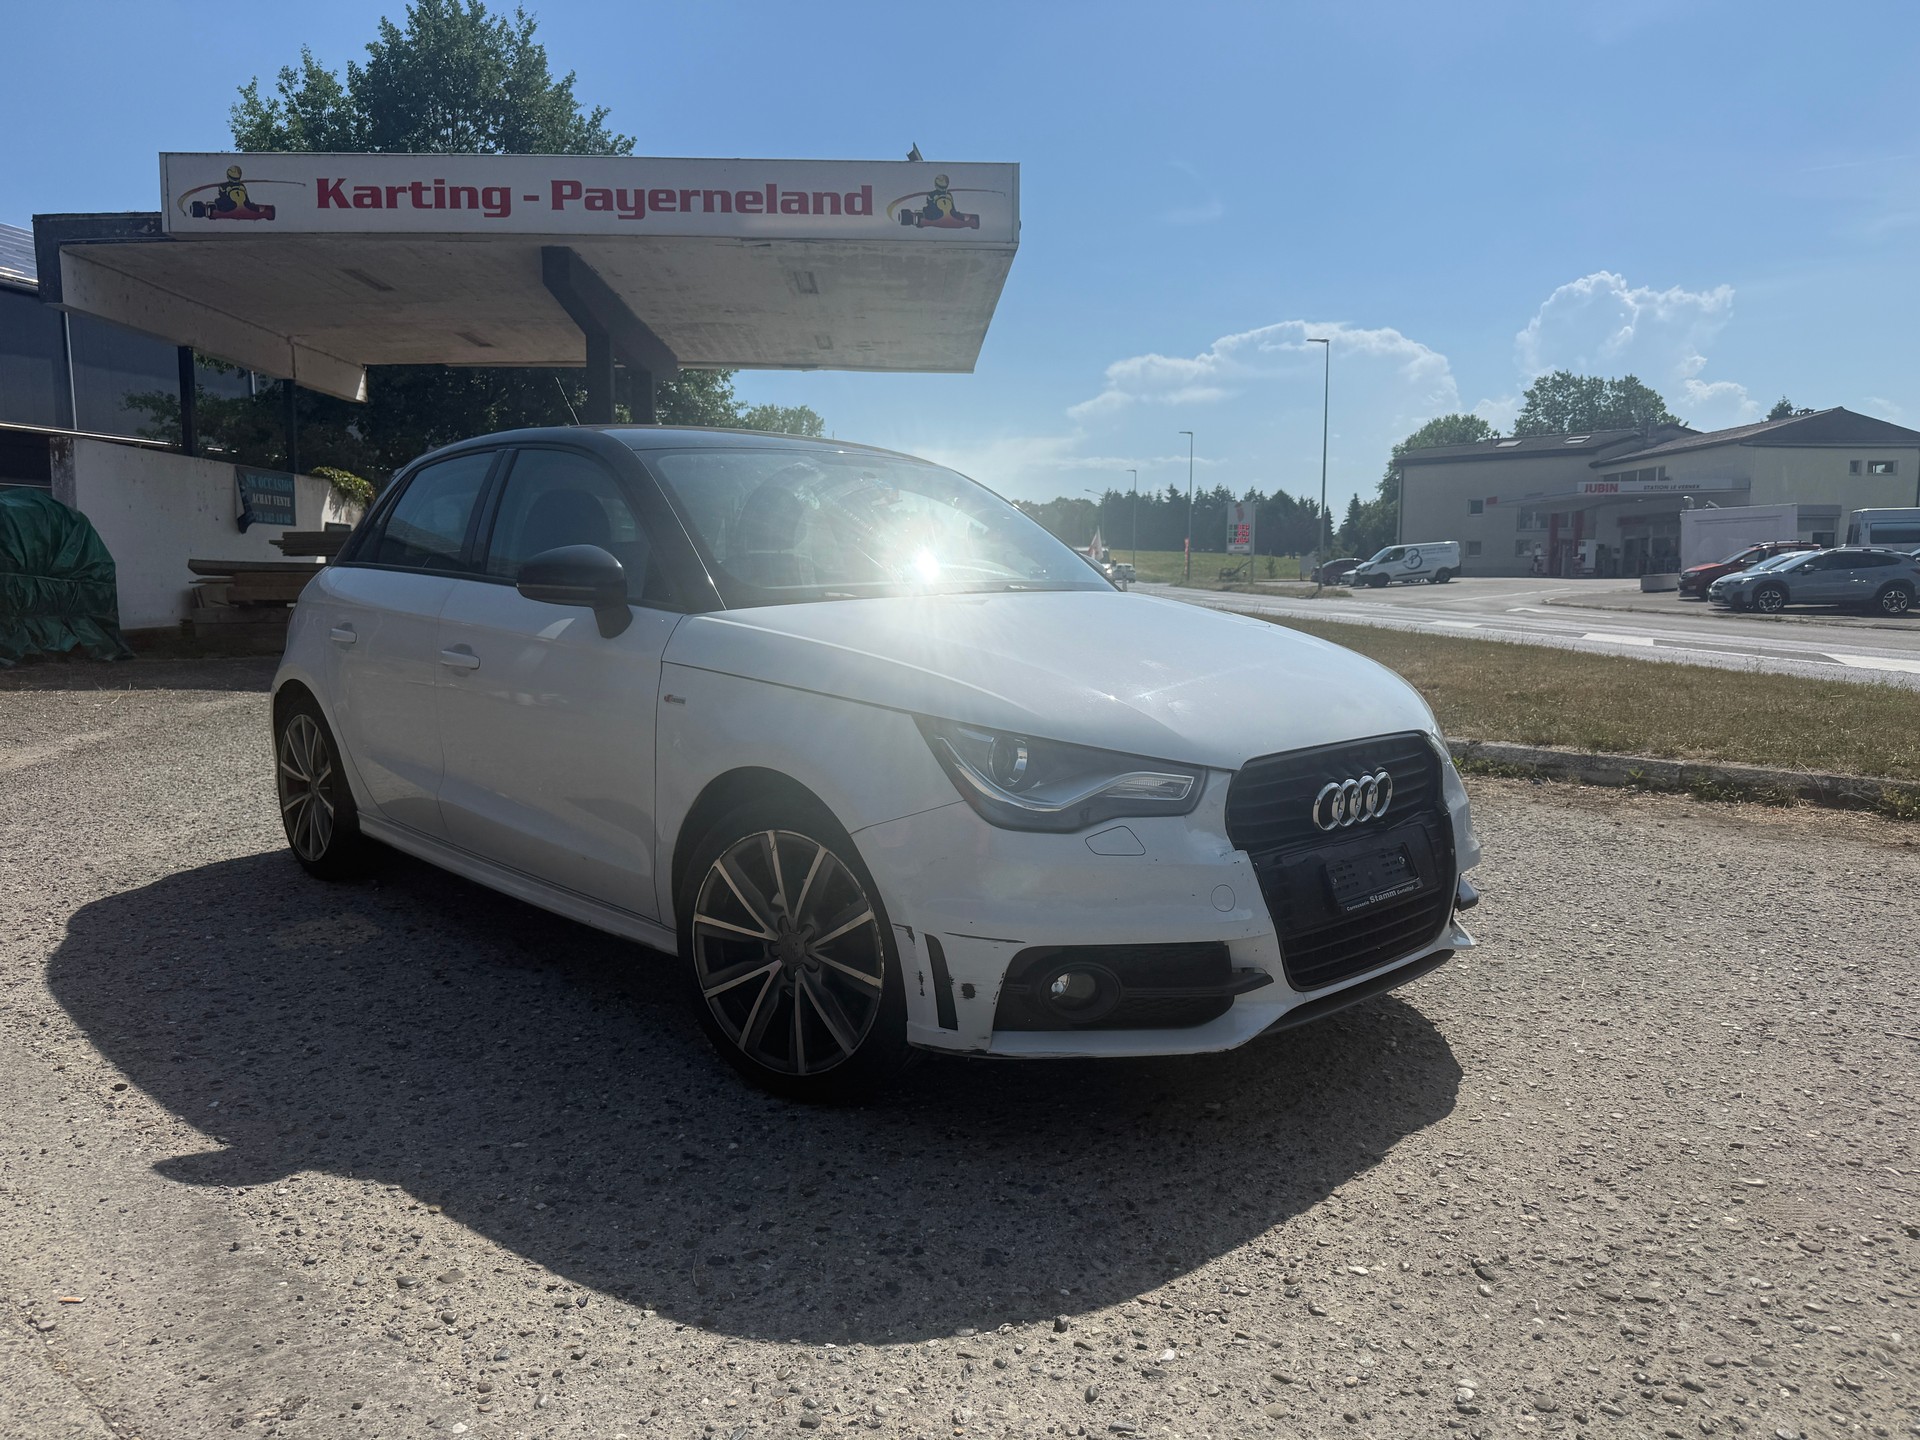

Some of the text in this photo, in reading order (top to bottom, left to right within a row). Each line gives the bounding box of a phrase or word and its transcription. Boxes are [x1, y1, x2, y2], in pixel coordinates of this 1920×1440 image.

[315, 177, 874, 220] Karting - Payerneland
[258, 477, 294, 493] OCCASION
[1584, 483, 1619, 494] JUBIN
[252, 493, 291, 507] ACHAT VENTE
[1369, 889, 1397, 904] Stamm
